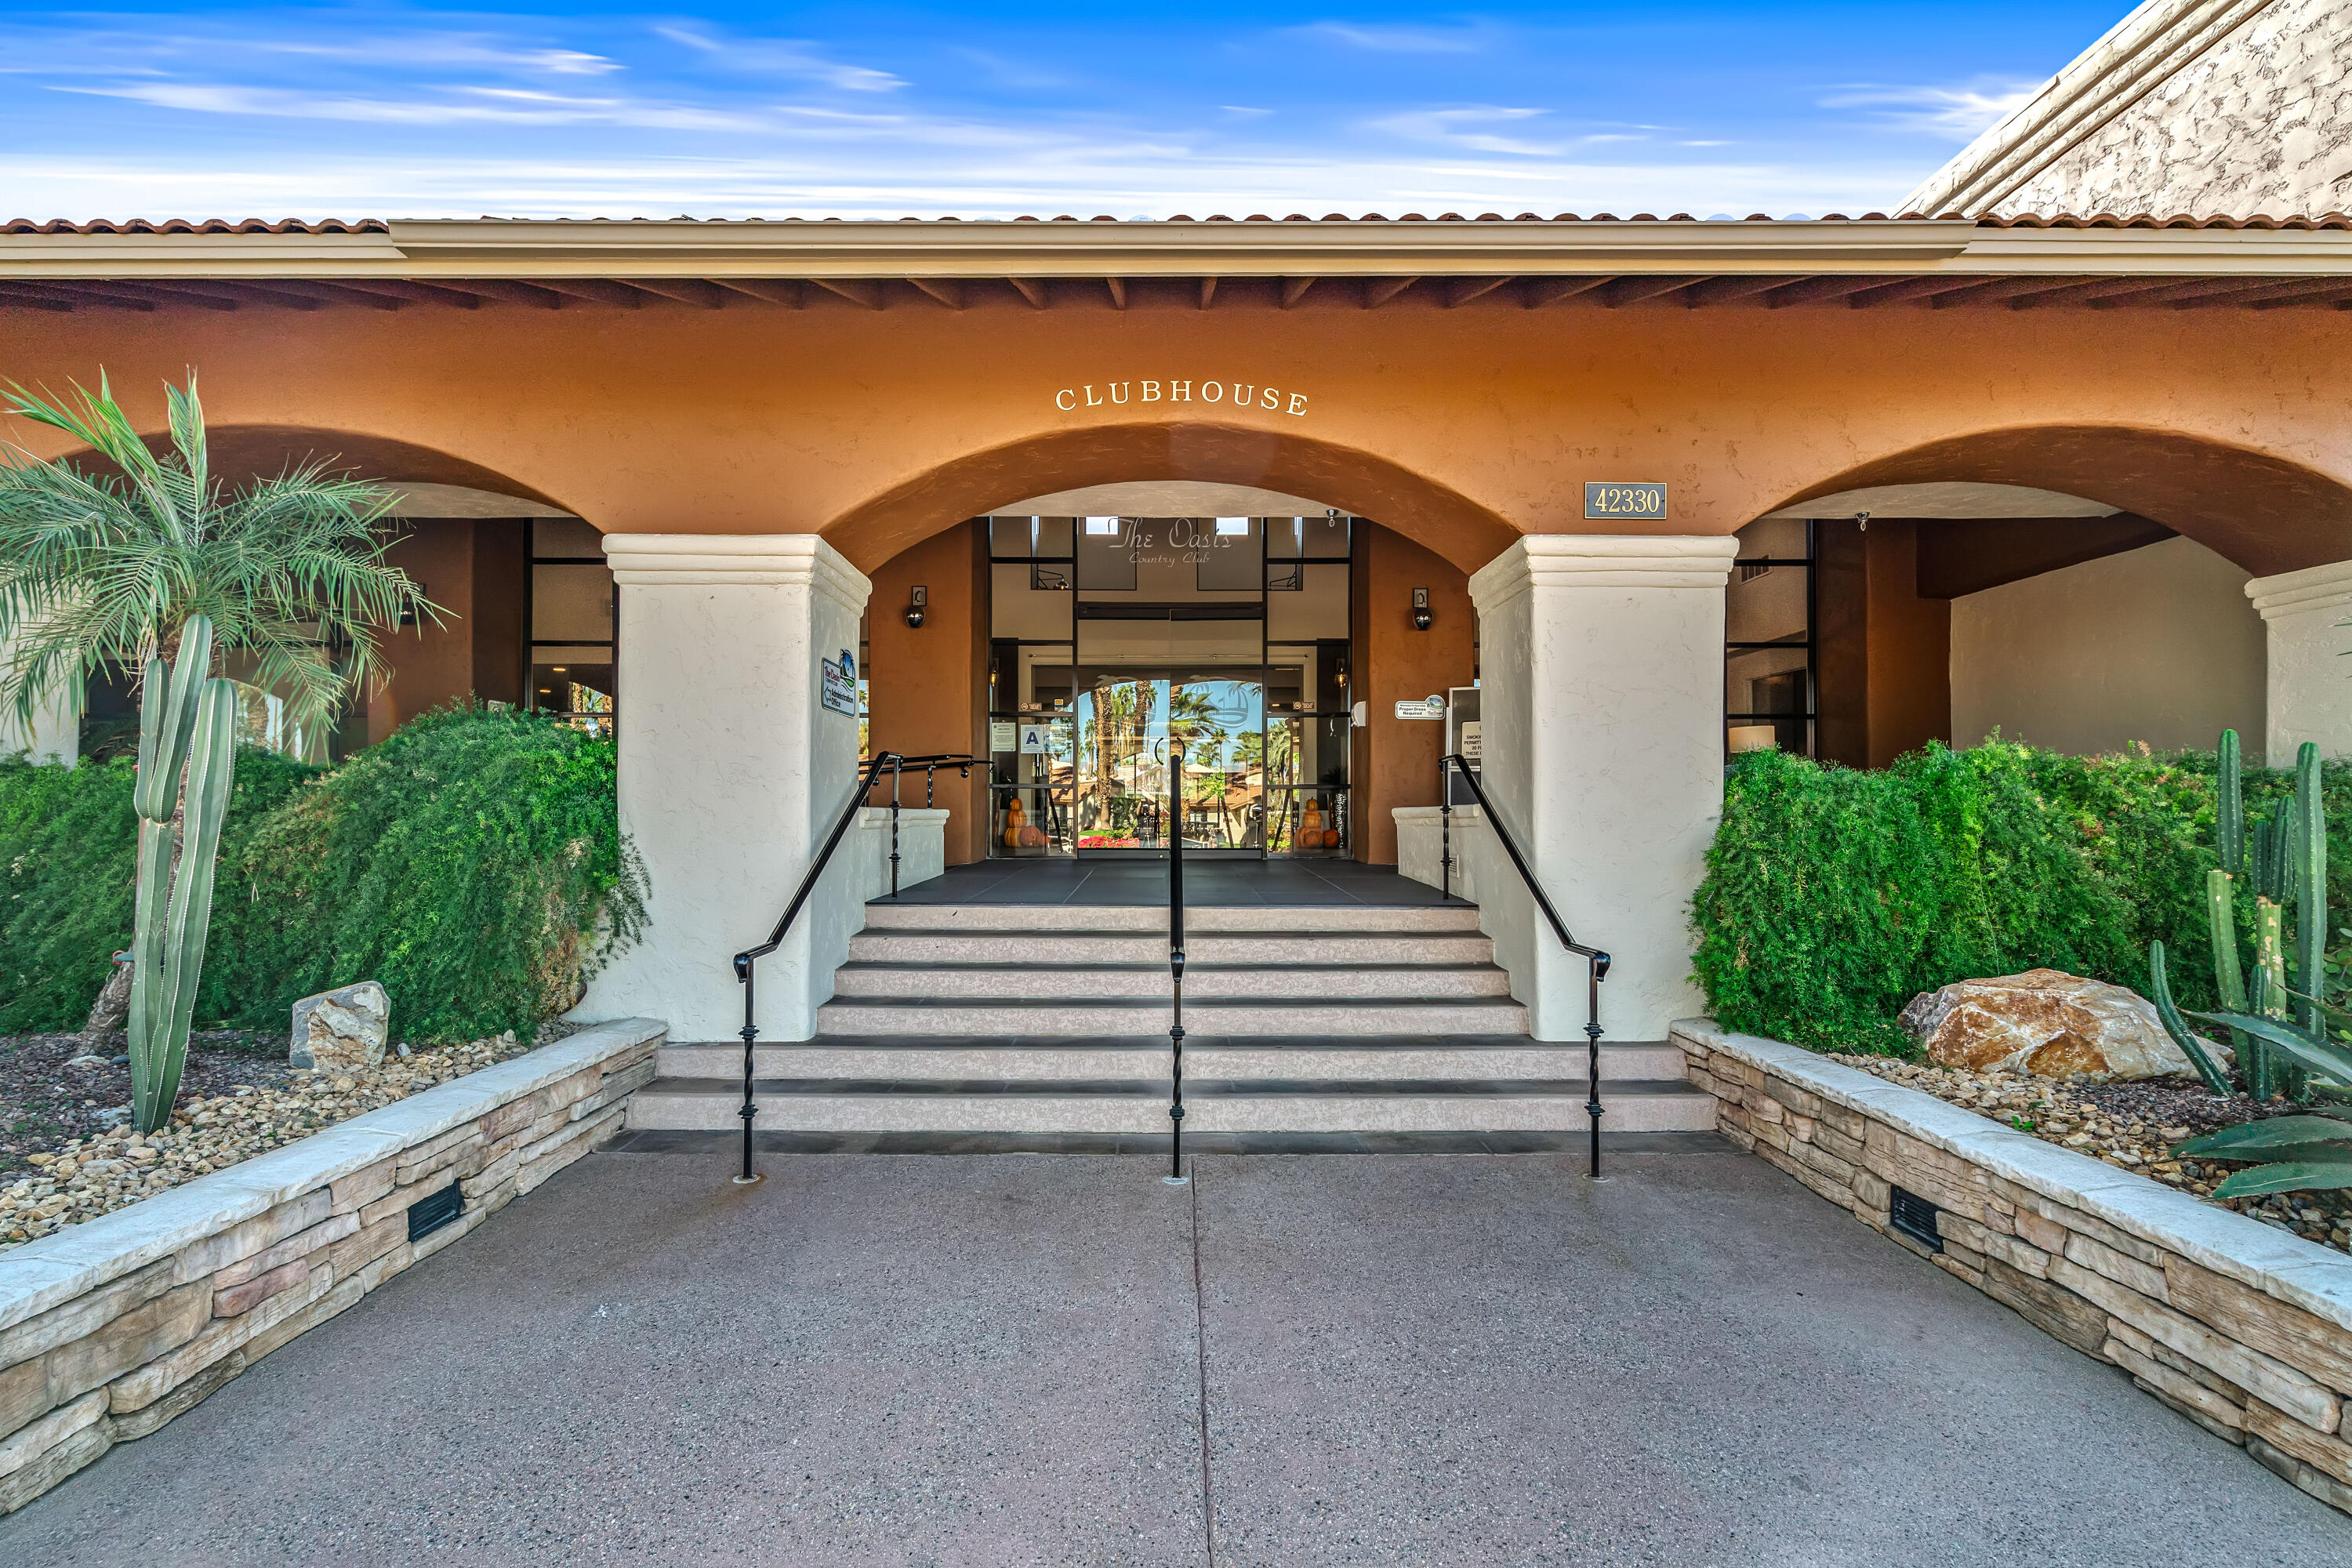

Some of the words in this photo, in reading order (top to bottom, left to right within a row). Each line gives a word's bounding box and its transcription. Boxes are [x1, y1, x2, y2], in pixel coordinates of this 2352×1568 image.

[1055, 380, 1308, 416] CLUBHOUSE
[1594, 488, 1660, 513] 42330
[1108, 517, 1153, 548] The
[1169, 517, 1233, 548] Oasis
[1129, 551, 1175, 568] Country
[1182, 551, 1210, 563] Club
[832, 688, 854, 703] Administration
[832, 697, 841, 708] Office
[1025, 731, 1039, 745] A
